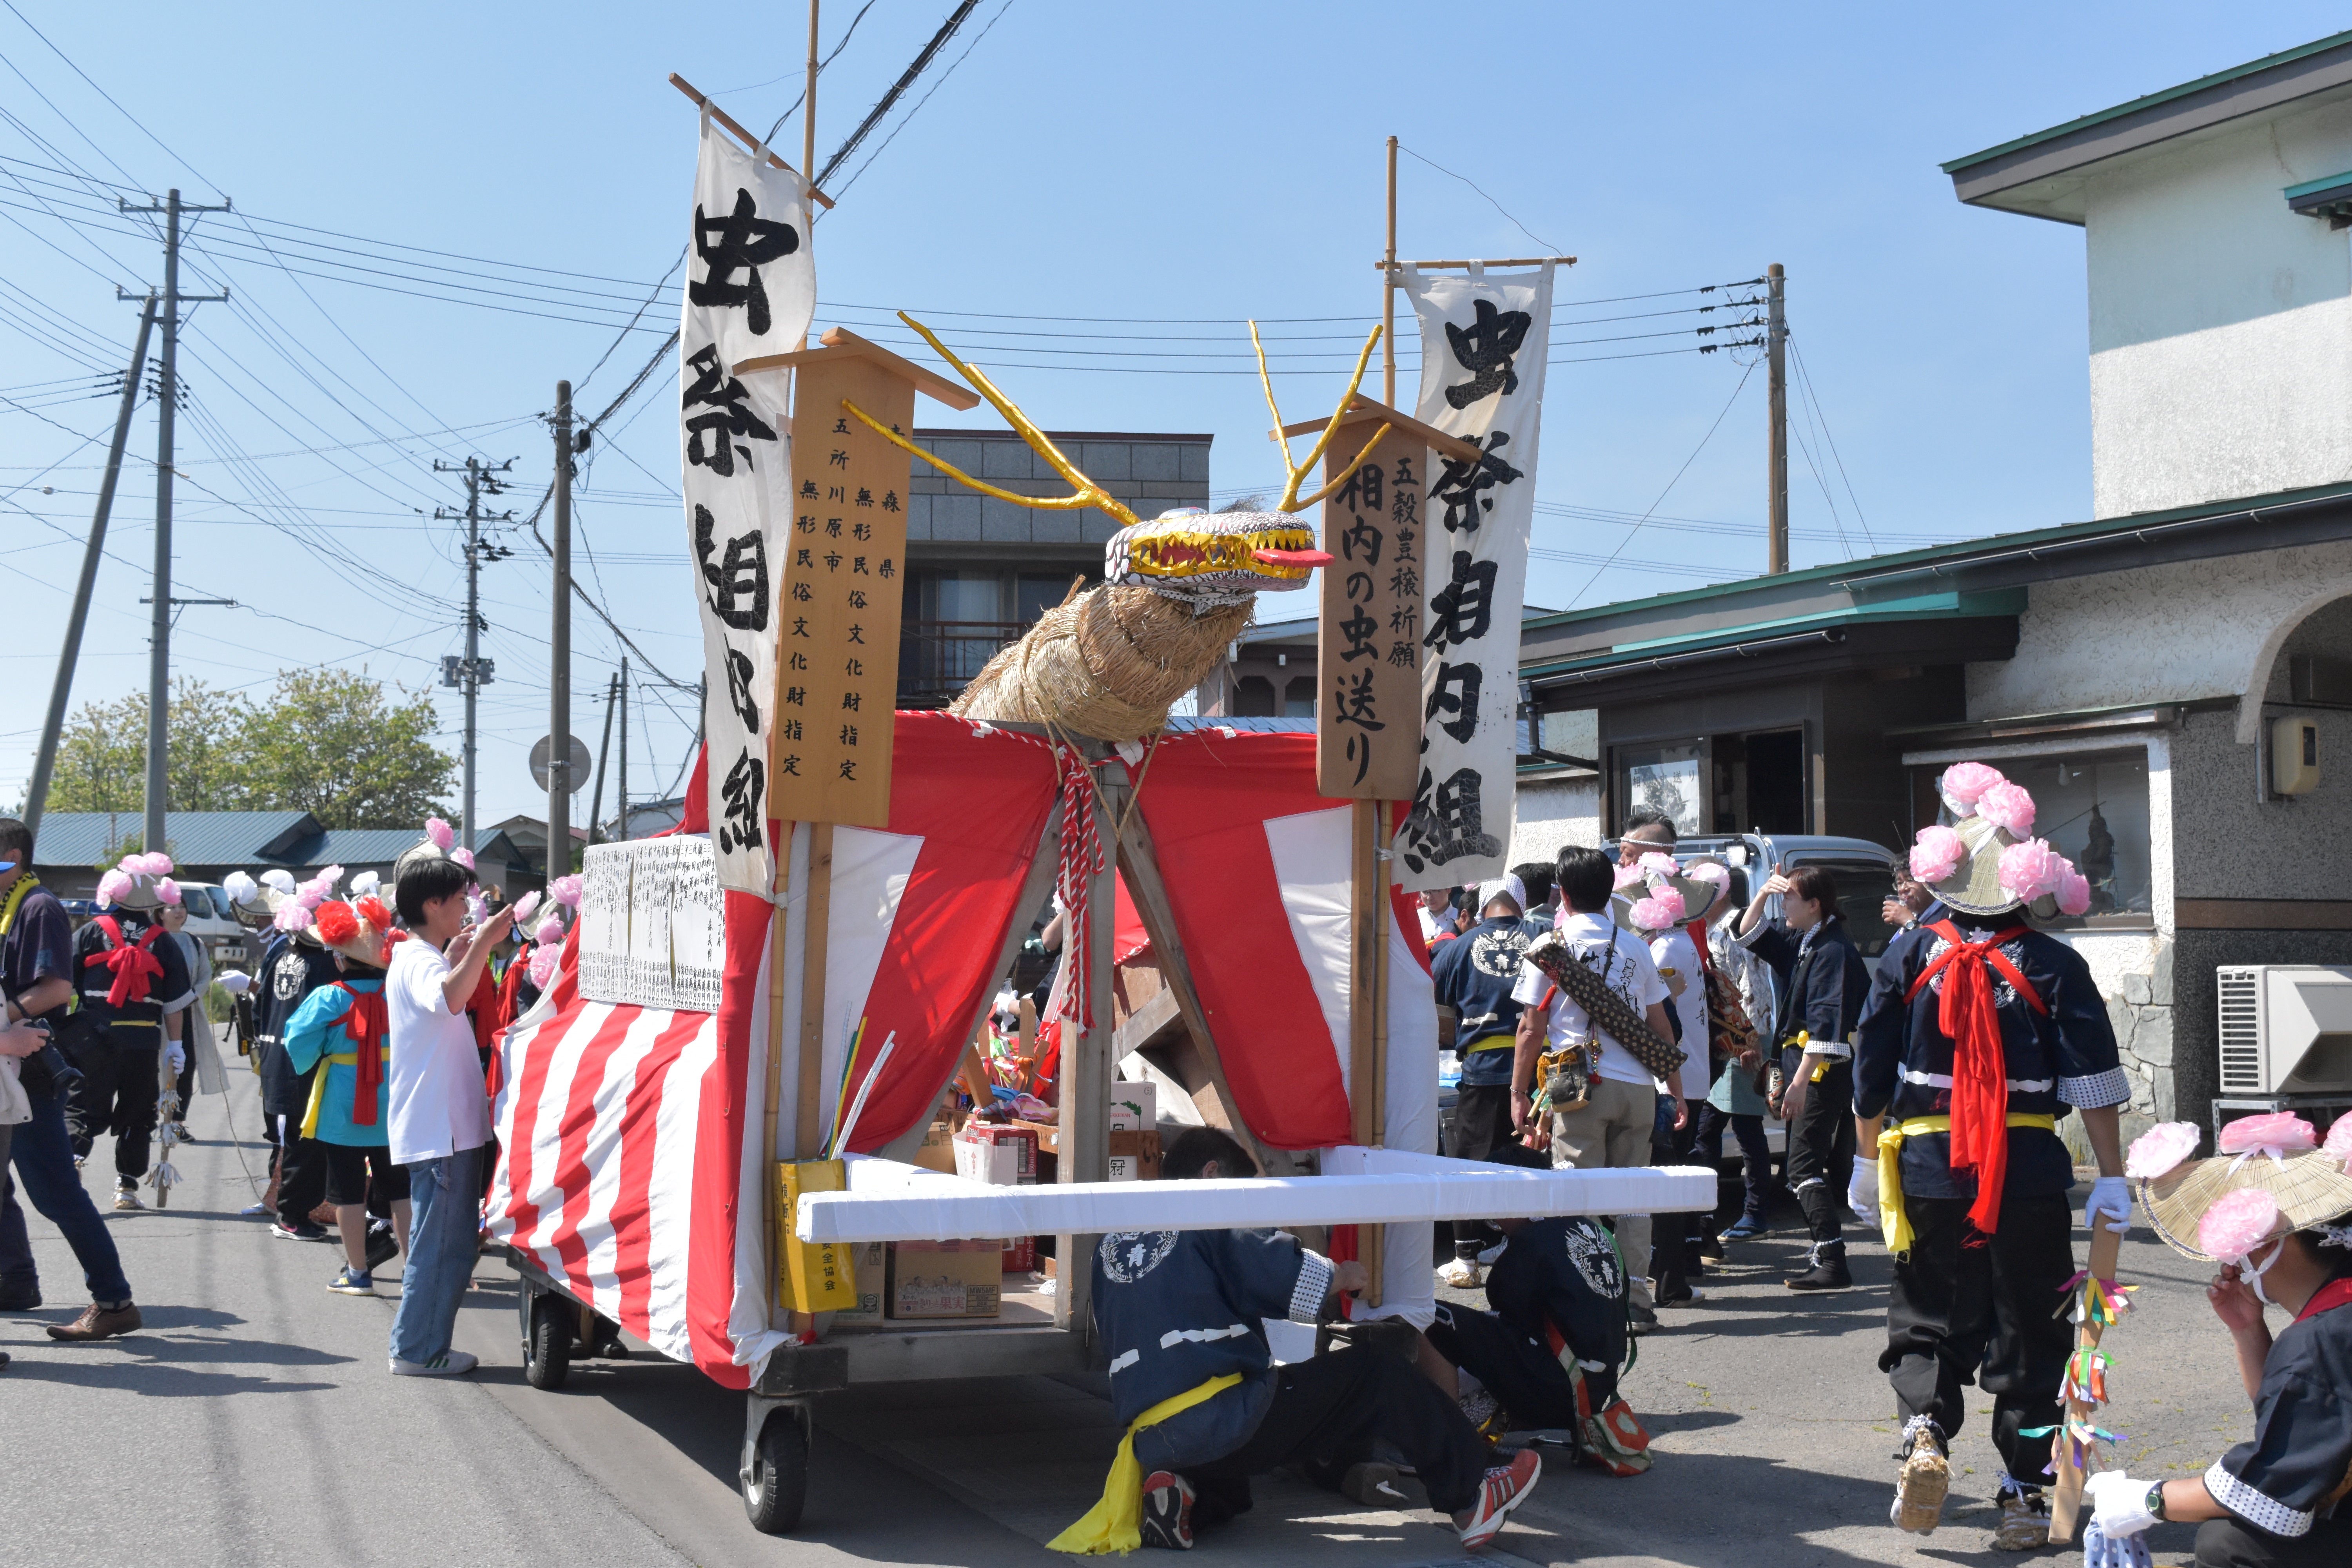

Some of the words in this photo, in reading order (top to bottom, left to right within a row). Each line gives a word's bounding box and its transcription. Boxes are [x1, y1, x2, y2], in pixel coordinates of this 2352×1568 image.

[823, 419, 851, 573] 五所川原市
[1387, 457, 1419, 669] 五穀豊穣祈願
[782, 480, 820, 776] 無形民俗文化財指定
[839, 487, 875, 780] 無形民俗文化財指定
[1334, 456, 1385, 787] 相内の虫送り
[1494, 954, 1509, 969] 青
[1109, 1160, 1125, 1176] 冠
[1127, 1243, 1146, 1267] 青
[1601, 1260, 1614, 1285] 青
